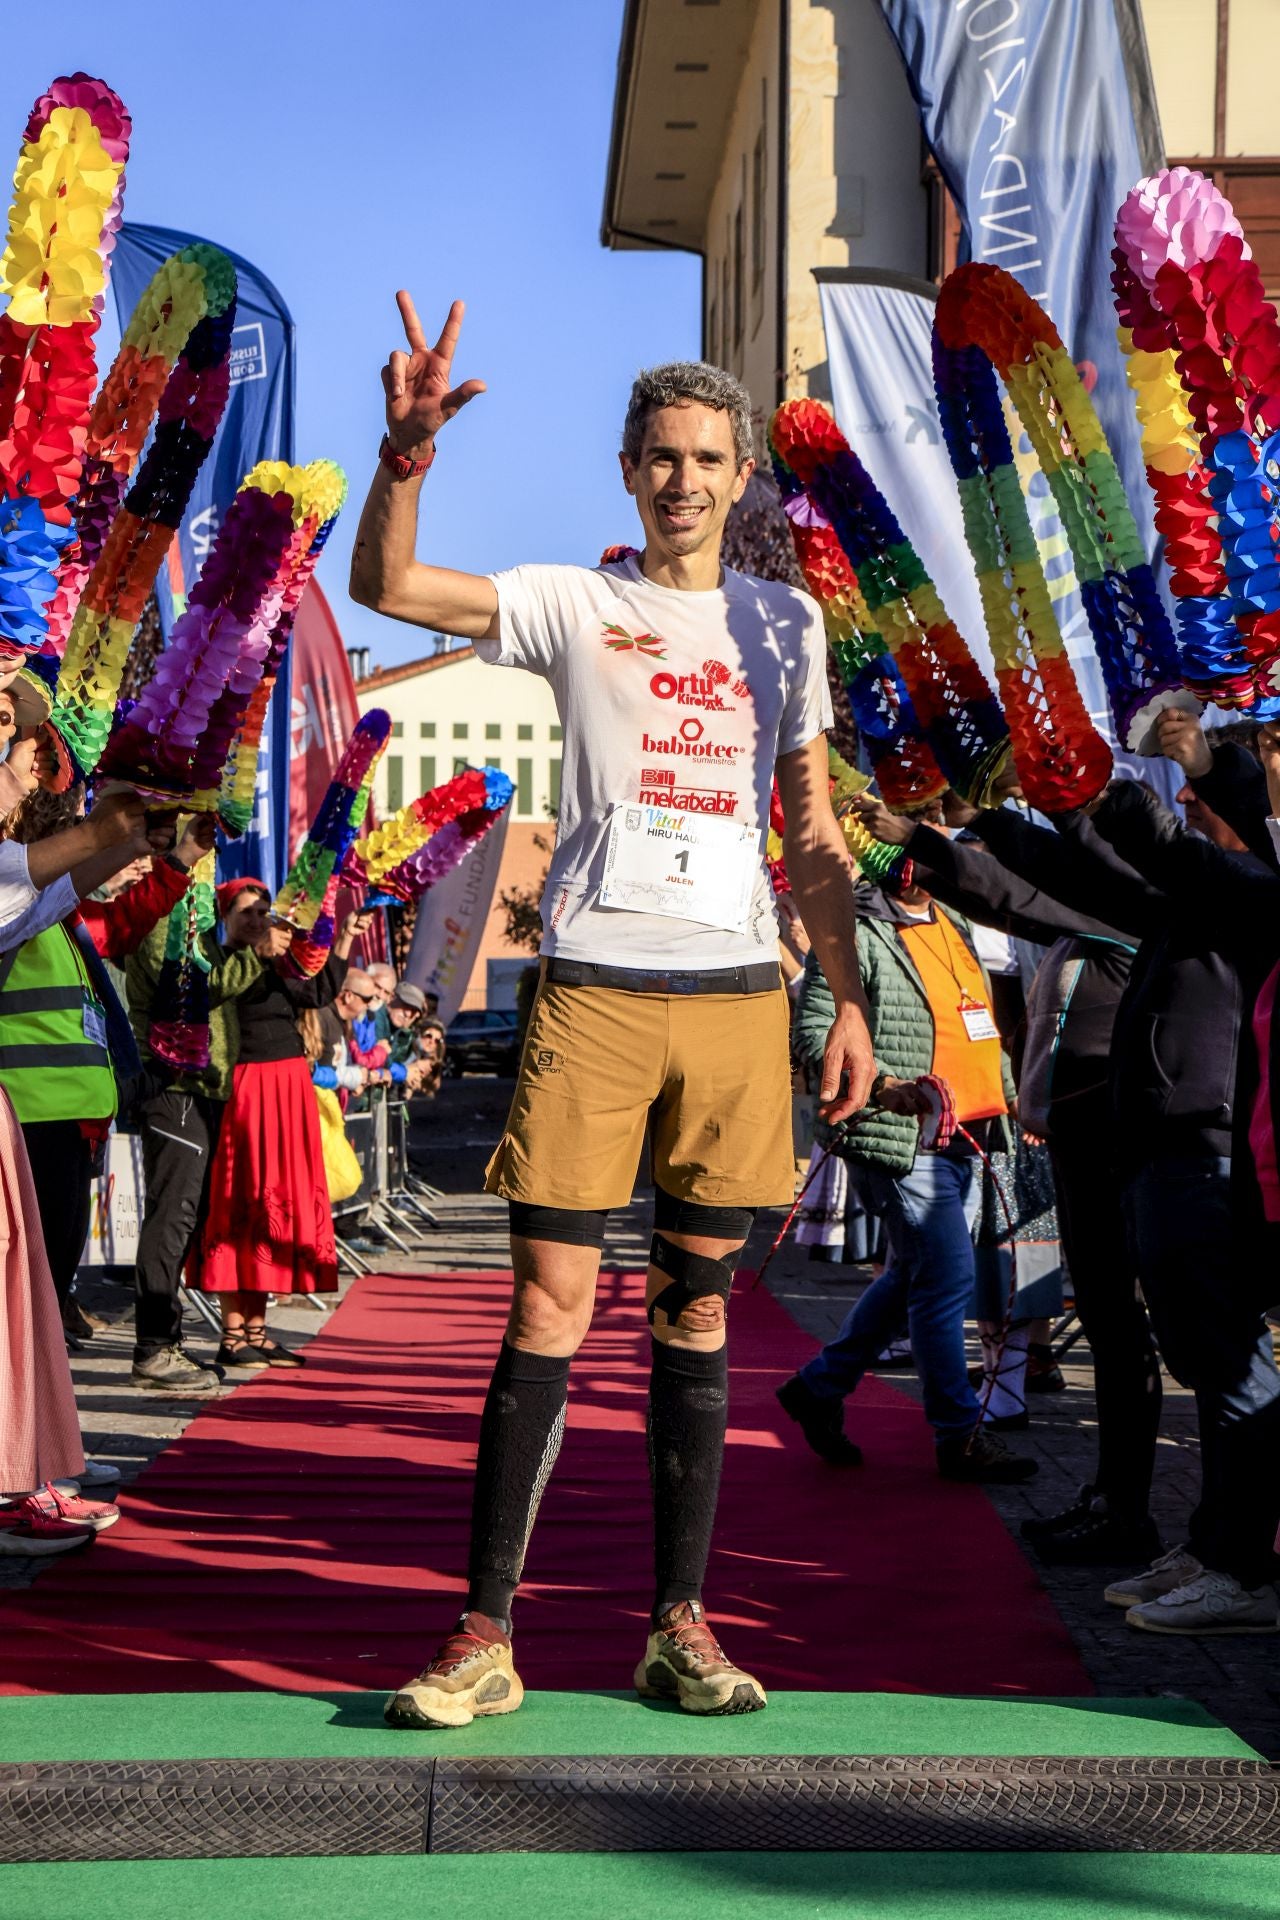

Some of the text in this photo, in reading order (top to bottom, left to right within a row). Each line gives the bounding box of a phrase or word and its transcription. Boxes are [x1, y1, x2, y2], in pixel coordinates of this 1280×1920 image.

[650, 672, 714, 699] Ortu
[692, 756, 737, 766] suministros
[638, 787, 739, 815] mekatxabir
[645, 808, 686, 832] Vital
[646, 827, 673, 840] HIRU
[674, 849, 690, 873] 1
[665, 875, 695, 887] JULEN
